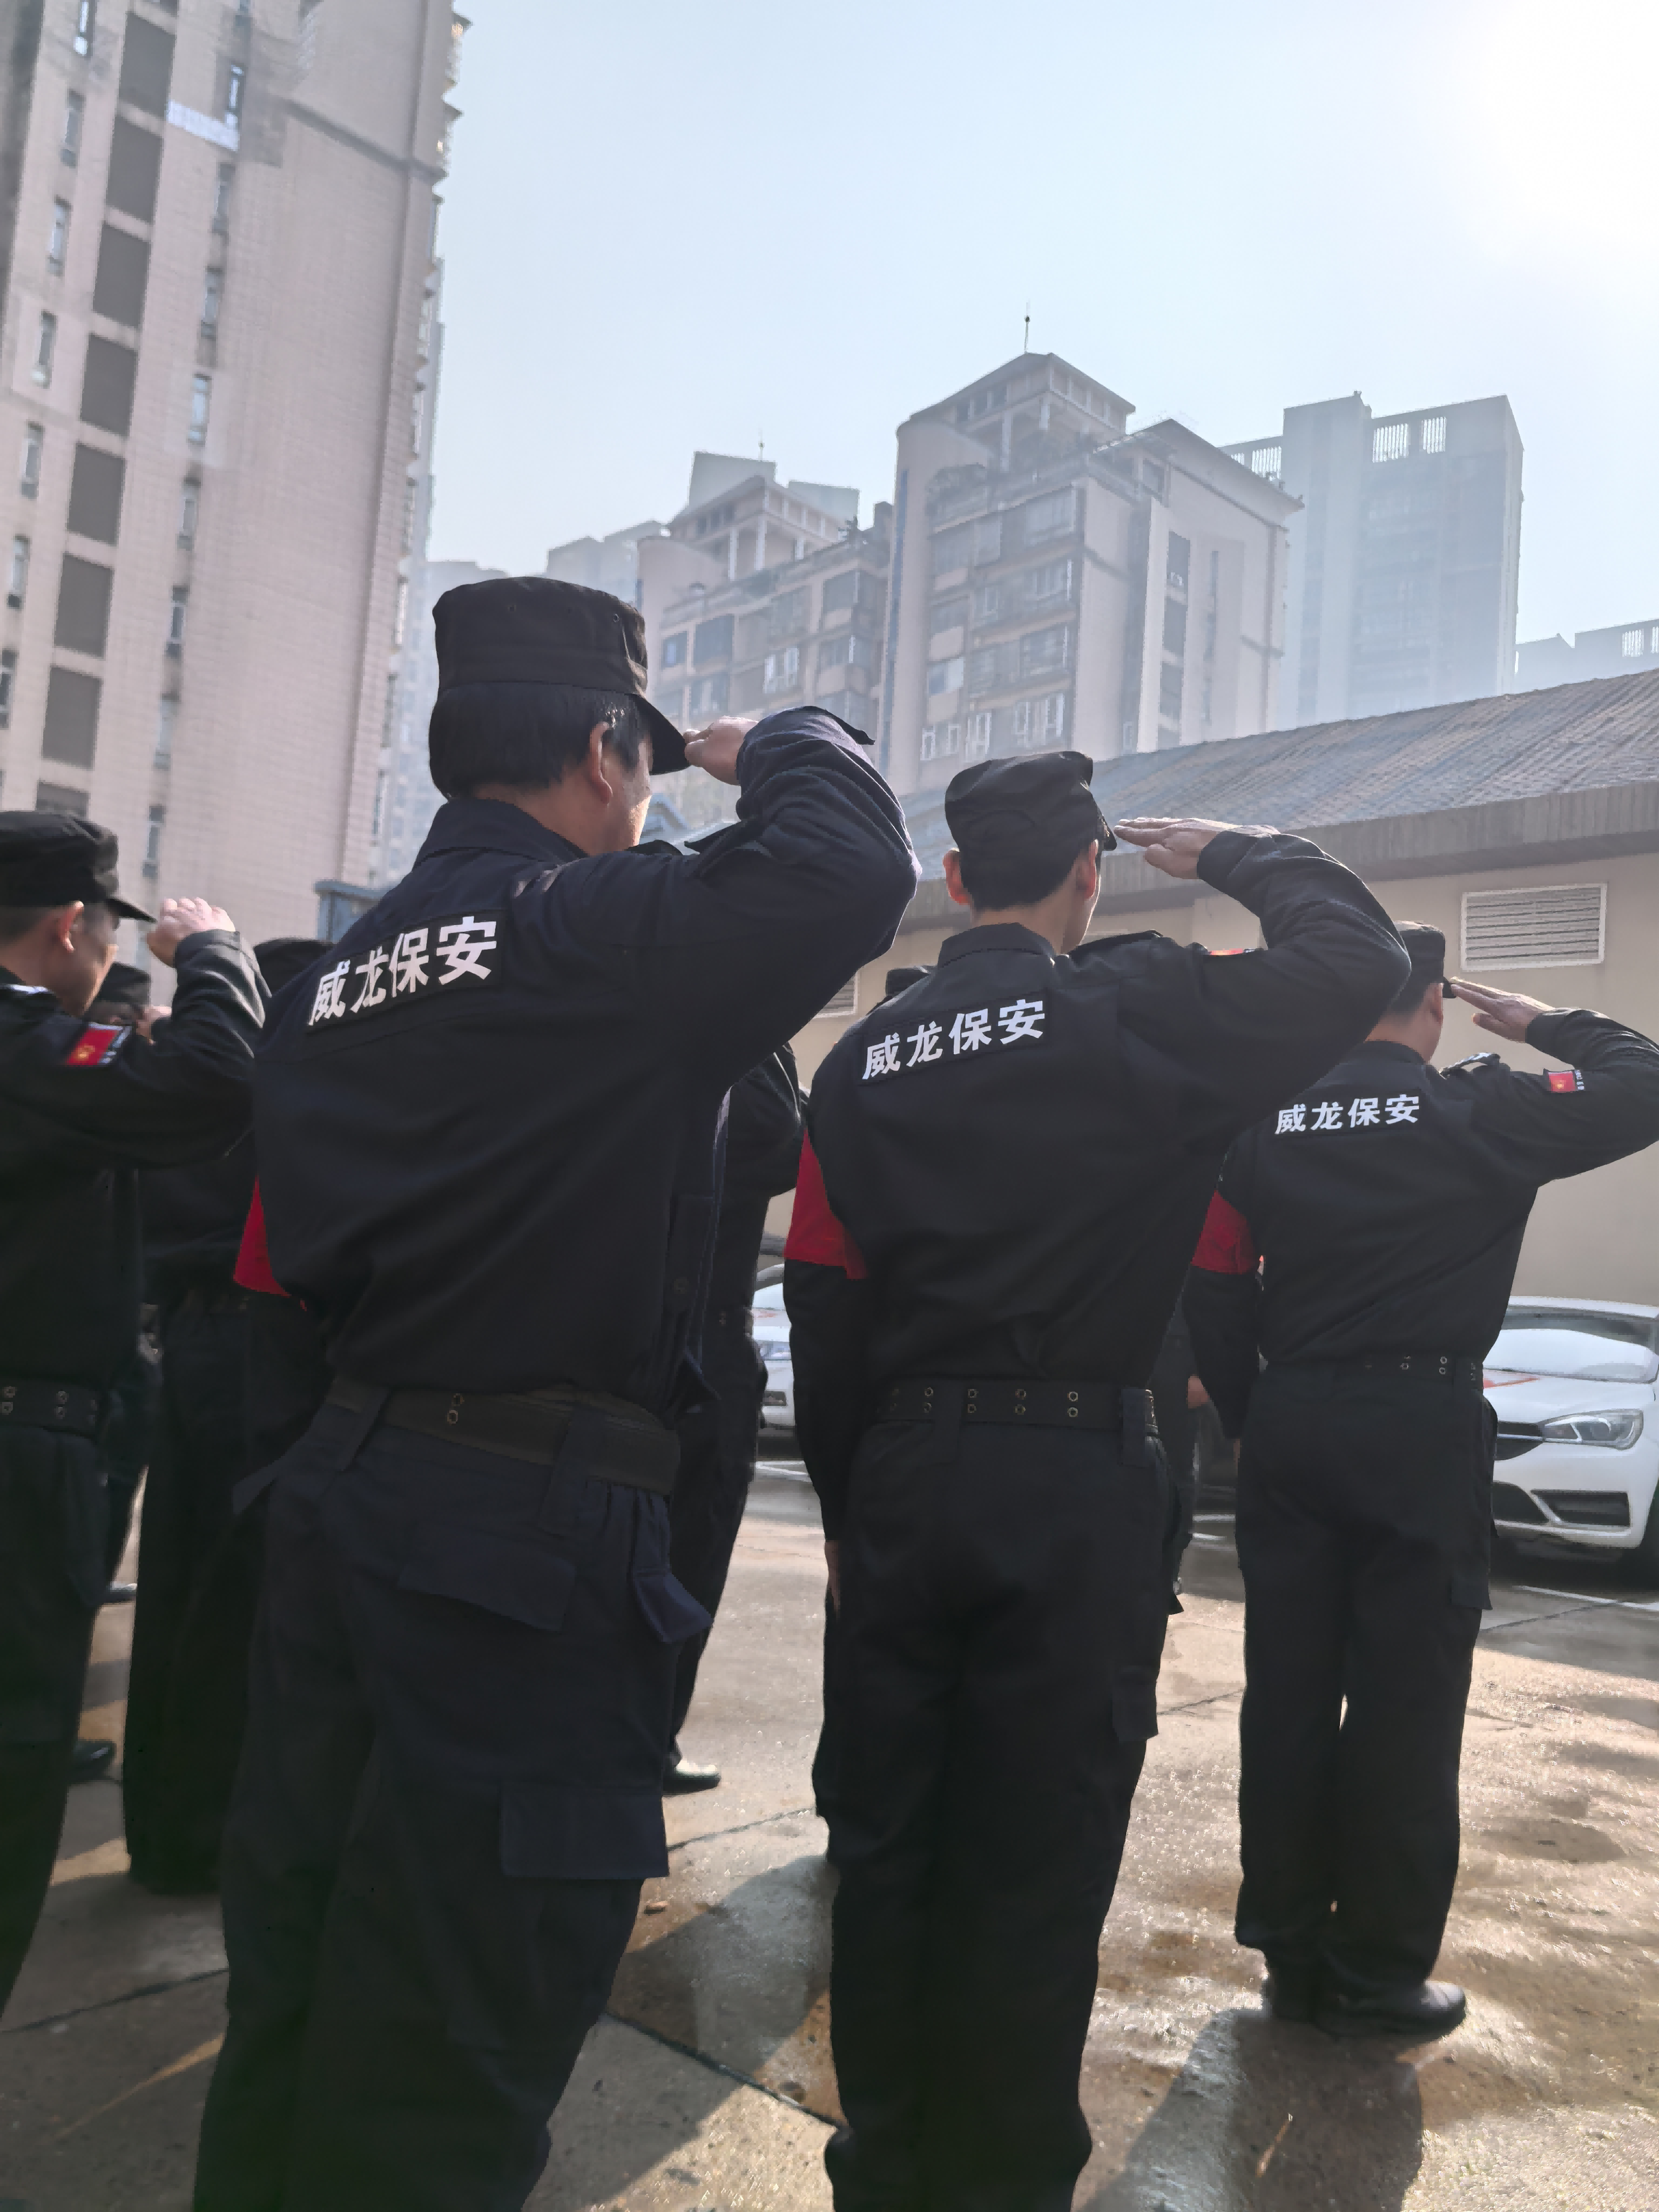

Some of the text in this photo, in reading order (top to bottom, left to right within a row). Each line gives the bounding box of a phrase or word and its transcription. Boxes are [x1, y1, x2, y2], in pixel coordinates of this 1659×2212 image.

[308, 915, 497, 1026] 威龙保安
[861, 999, 1046, 1080] 威龙保安
[1274, 1094, 1420, 1135] 威龙保安
